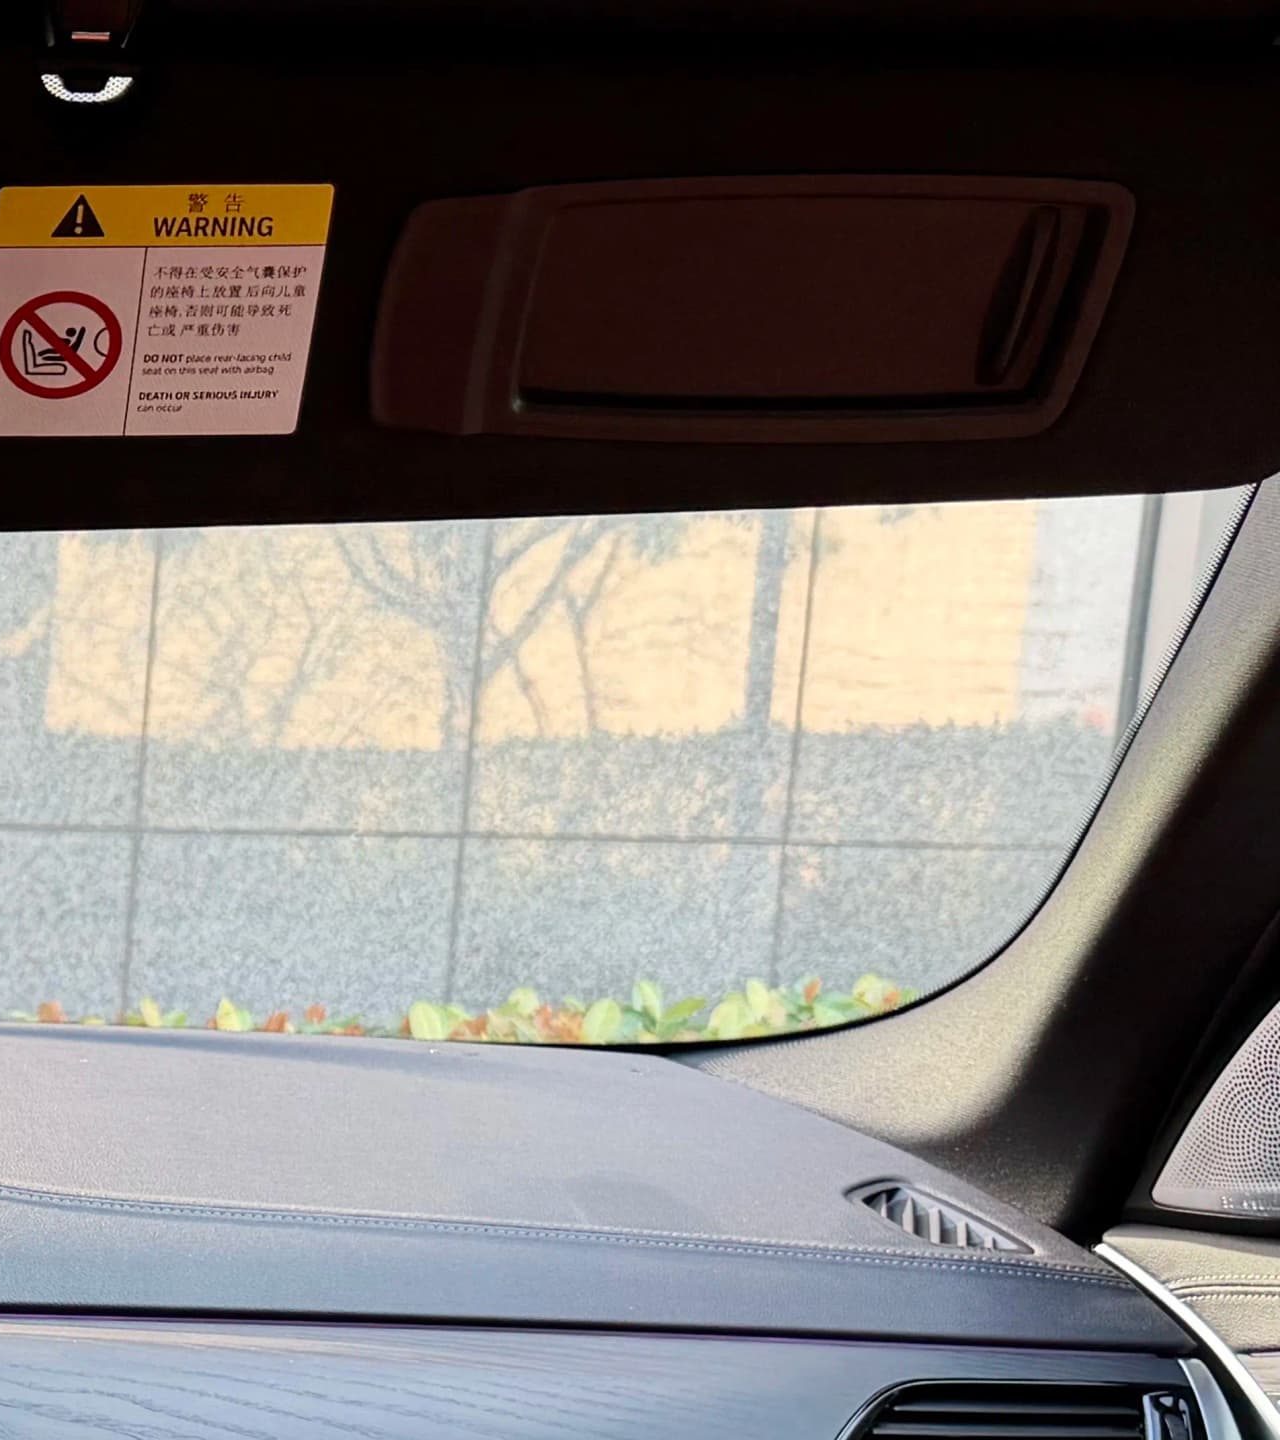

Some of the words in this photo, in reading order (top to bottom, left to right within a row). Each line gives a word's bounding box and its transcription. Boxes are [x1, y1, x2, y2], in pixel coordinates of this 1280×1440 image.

[188, 193, 245, 213] 警告
[153, 216, 274, 237] WARNING
[154, 265, 307, 280] 不得在受安全气囊保护
[144, 354, 159, 363] DO
[161, 354, 184, 363] NOT
[185, 354, 211, 364] place
[268, 353, 292, 362] child
[142, 367, 162, 376] seat
[179, 366, 196, 375] this
[198, 366, 219, 375] seat
[221, 366, 242, 375] with
[243, 366, 274, 376] airbag
[139, 391, 173, 401] DEATH
[175, 391, 190, 400] OR
[192, 391, 238, 400] SERIOUS
[240, 390, 279, 400] INJURY
